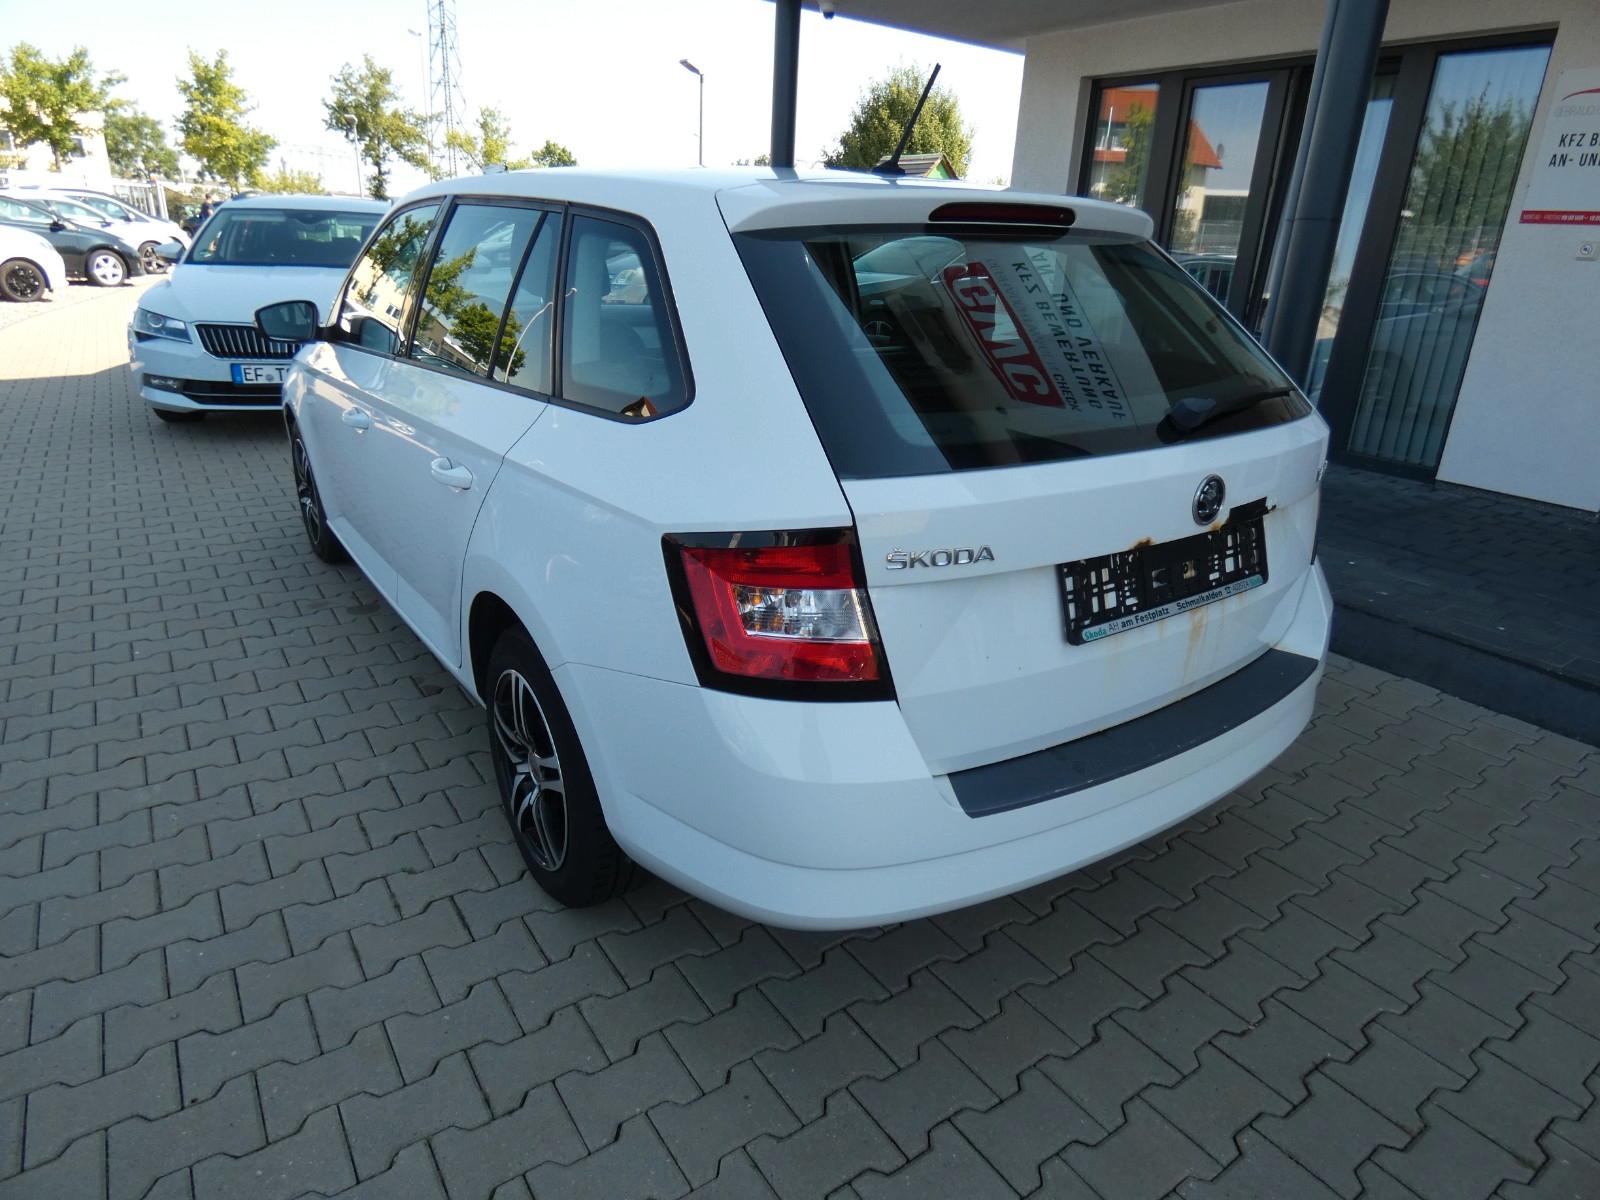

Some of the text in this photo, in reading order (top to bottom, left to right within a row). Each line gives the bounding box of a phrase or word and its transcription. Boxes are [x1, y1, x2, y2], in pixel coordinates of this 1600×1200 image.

[1558, 132, 1600, 147] KFZ B
[1548, 153, 1574, 167] AN-
[243, 367, 264, 381] EF
[886, 545, 995, 570] ŠKODA
[1084, 628, 1107, 640] Skoda
[1121, 619, 1134, 628] am
[1134, 607, 1170, 623] Festplatz
[1176, 590, 1223, 610] Schmalkalden
